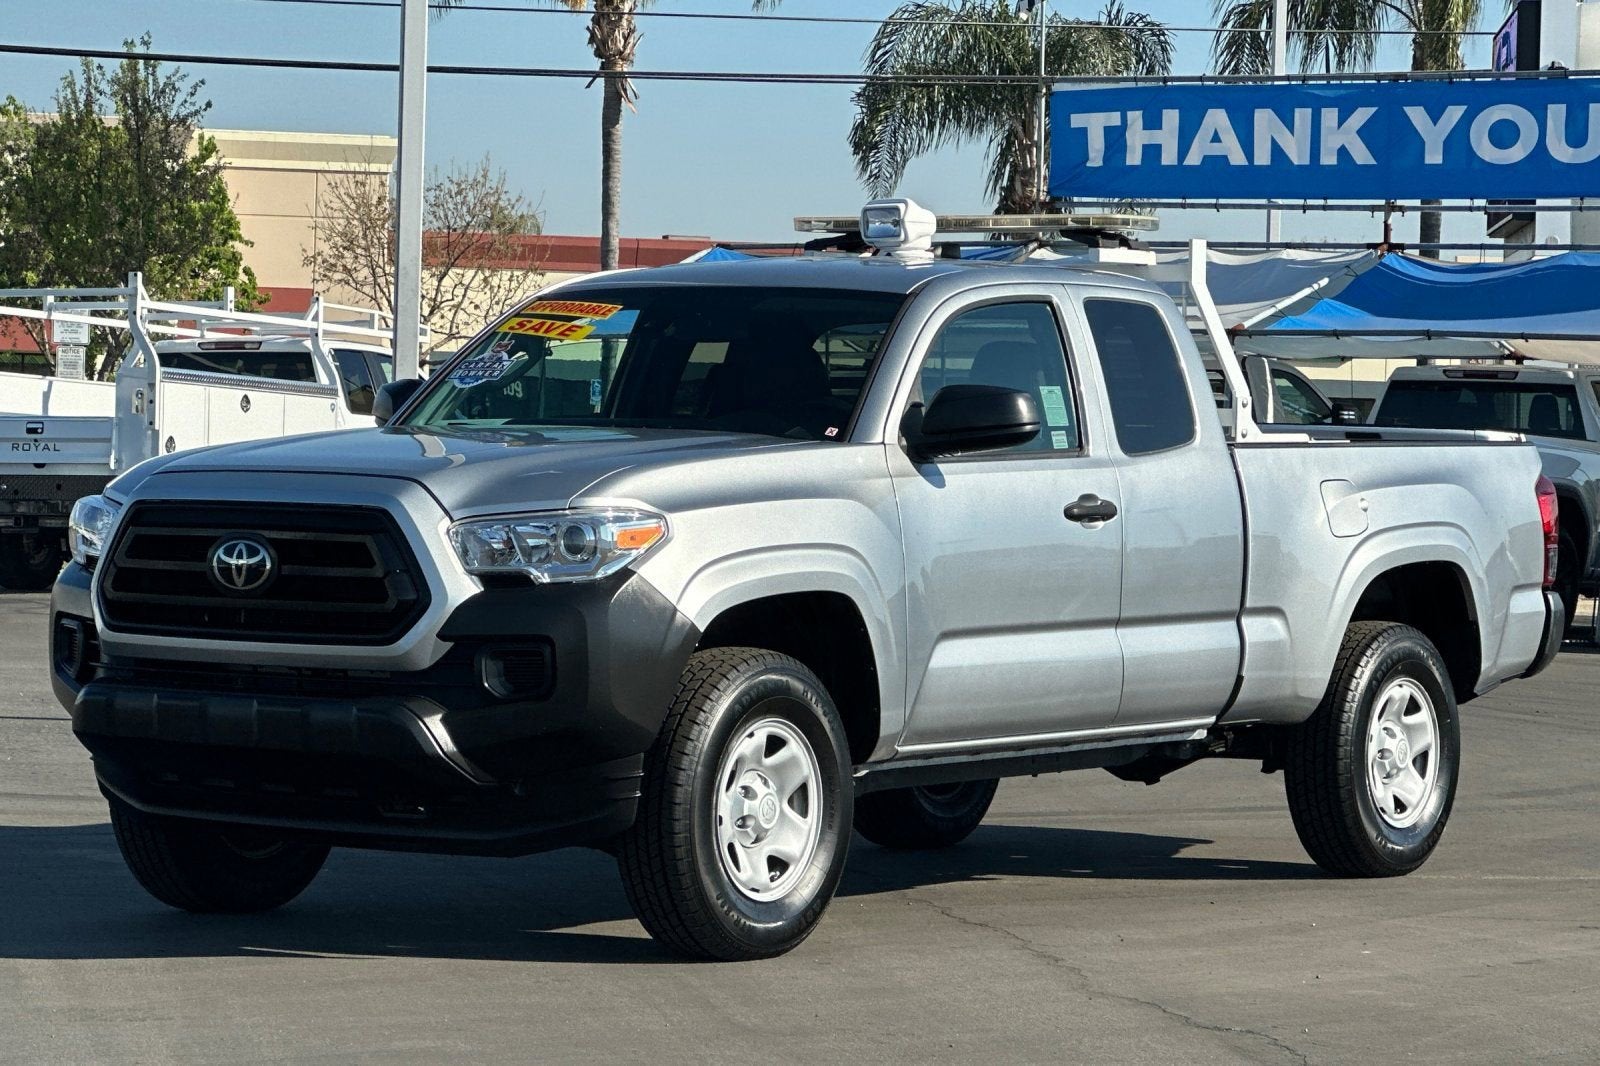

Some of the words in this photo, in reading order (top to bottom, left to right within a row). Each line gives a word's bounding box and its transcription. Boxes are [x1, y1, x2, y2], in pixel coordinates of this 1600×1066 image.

[1071, 106, 1378, 168] THANK
[1403, 103, 1600, 166] YOU
[528, 301, 620, 316] AFFORDABLE
[508, 319, 584, 337] SAVE
[461, 361, 508, 370] CARFAX
[11, 442, 61, 452] ROYAL
